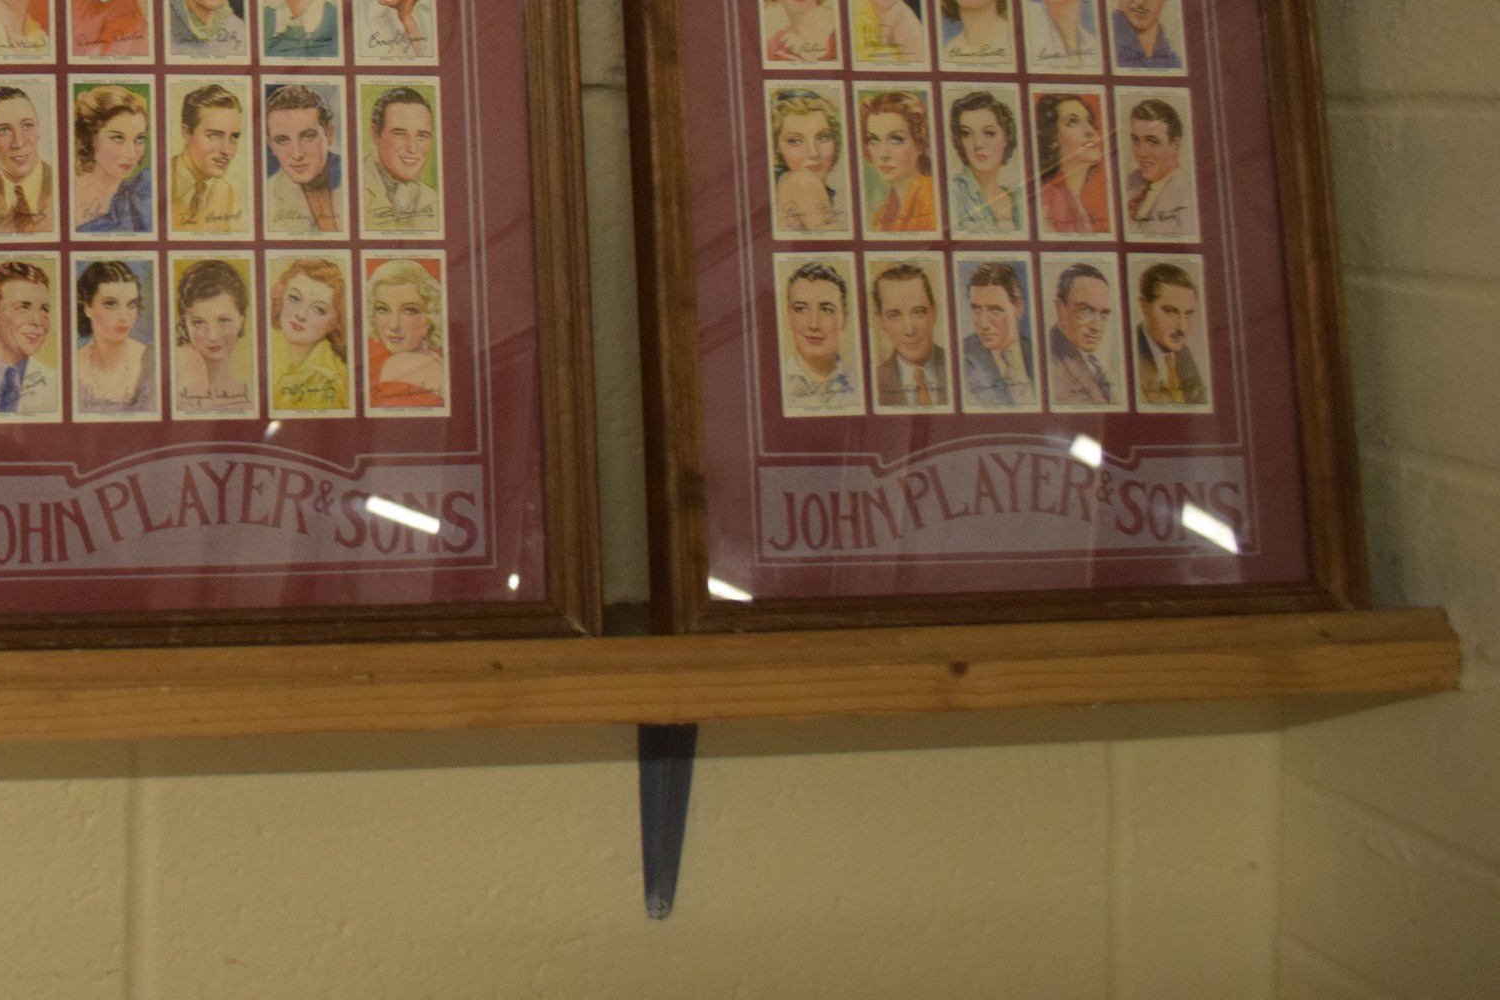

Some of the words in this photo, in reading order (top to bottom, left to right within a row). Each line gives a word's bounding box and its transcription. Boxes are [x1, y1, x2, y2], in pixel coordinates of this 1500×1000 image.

[94, 461, 315, 543] PLAYER
[334, 489, 479, 554] SONS
[768, 487, 902, 551] JOHN
[897, 452, 1095, 530] PLAYER
[1114, 479, 1244, 542] SONS
